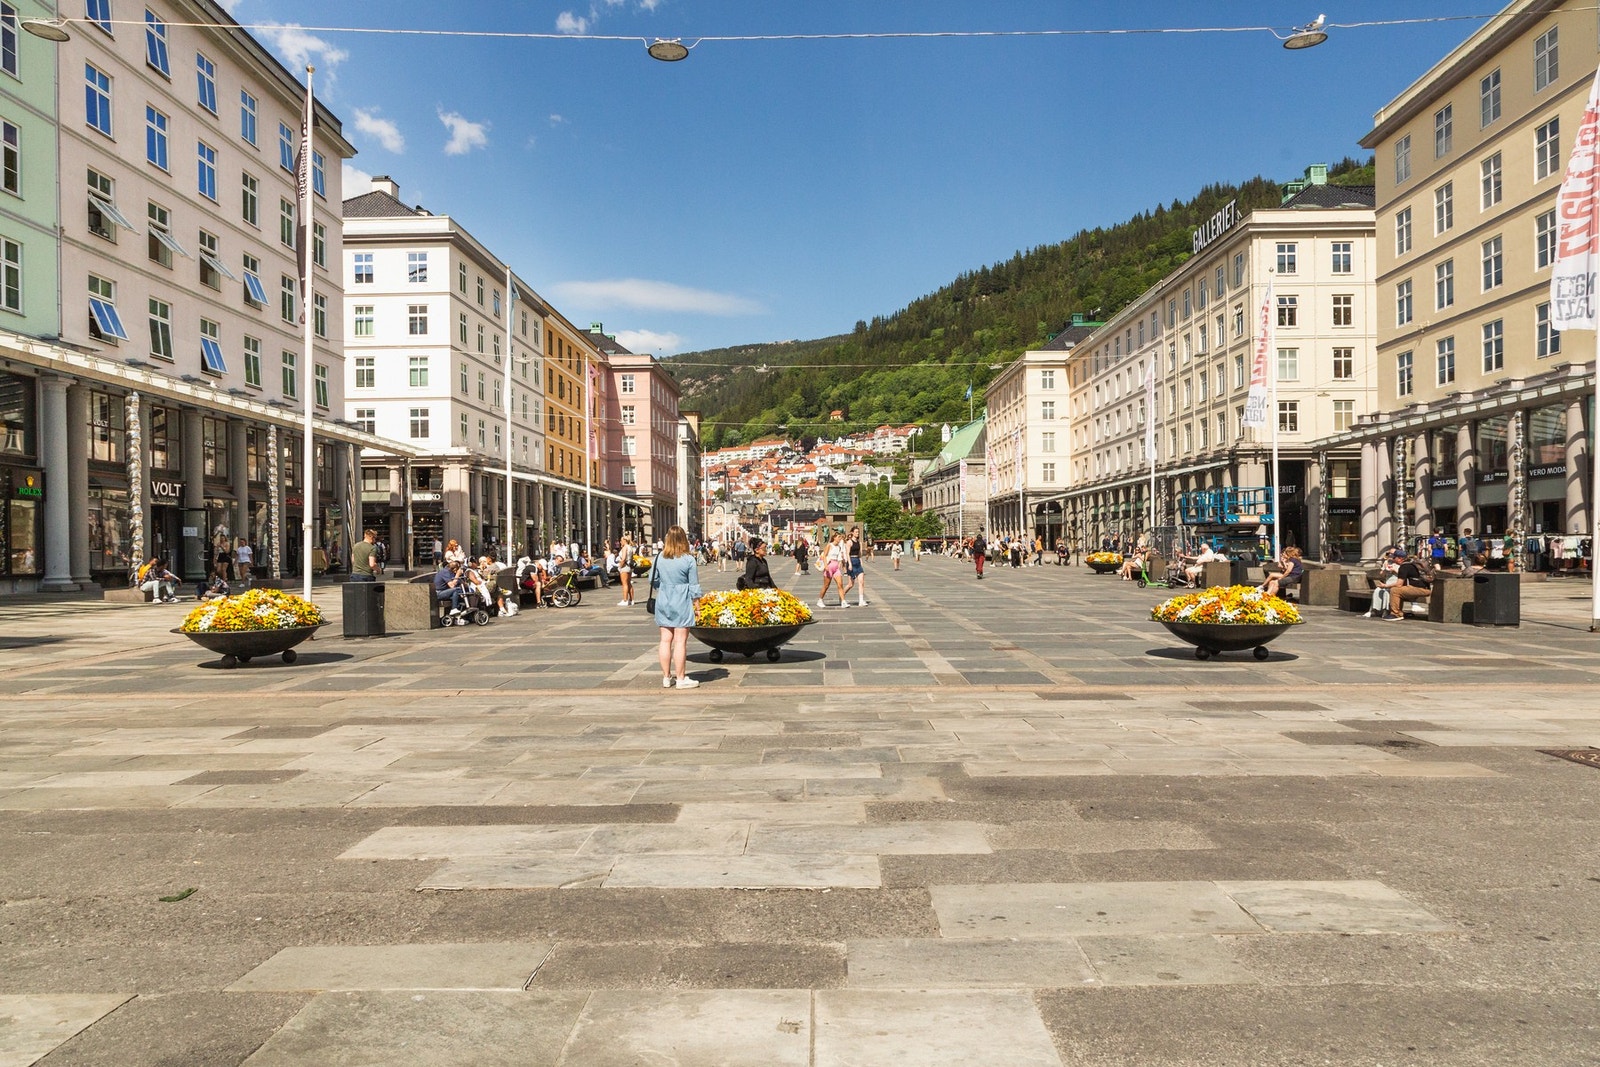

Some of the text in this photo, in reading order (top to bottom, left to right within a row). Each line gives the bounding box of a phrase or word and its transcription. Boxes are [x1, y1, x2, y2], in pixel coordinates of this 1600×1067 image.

[1193, 199, 1236, 254] GALLERIET
[1529, 466, 1567, 476] VERO MODA
[18, 487, 42, 497] ROLEX
[152, 481, 181, 496] VOLT
